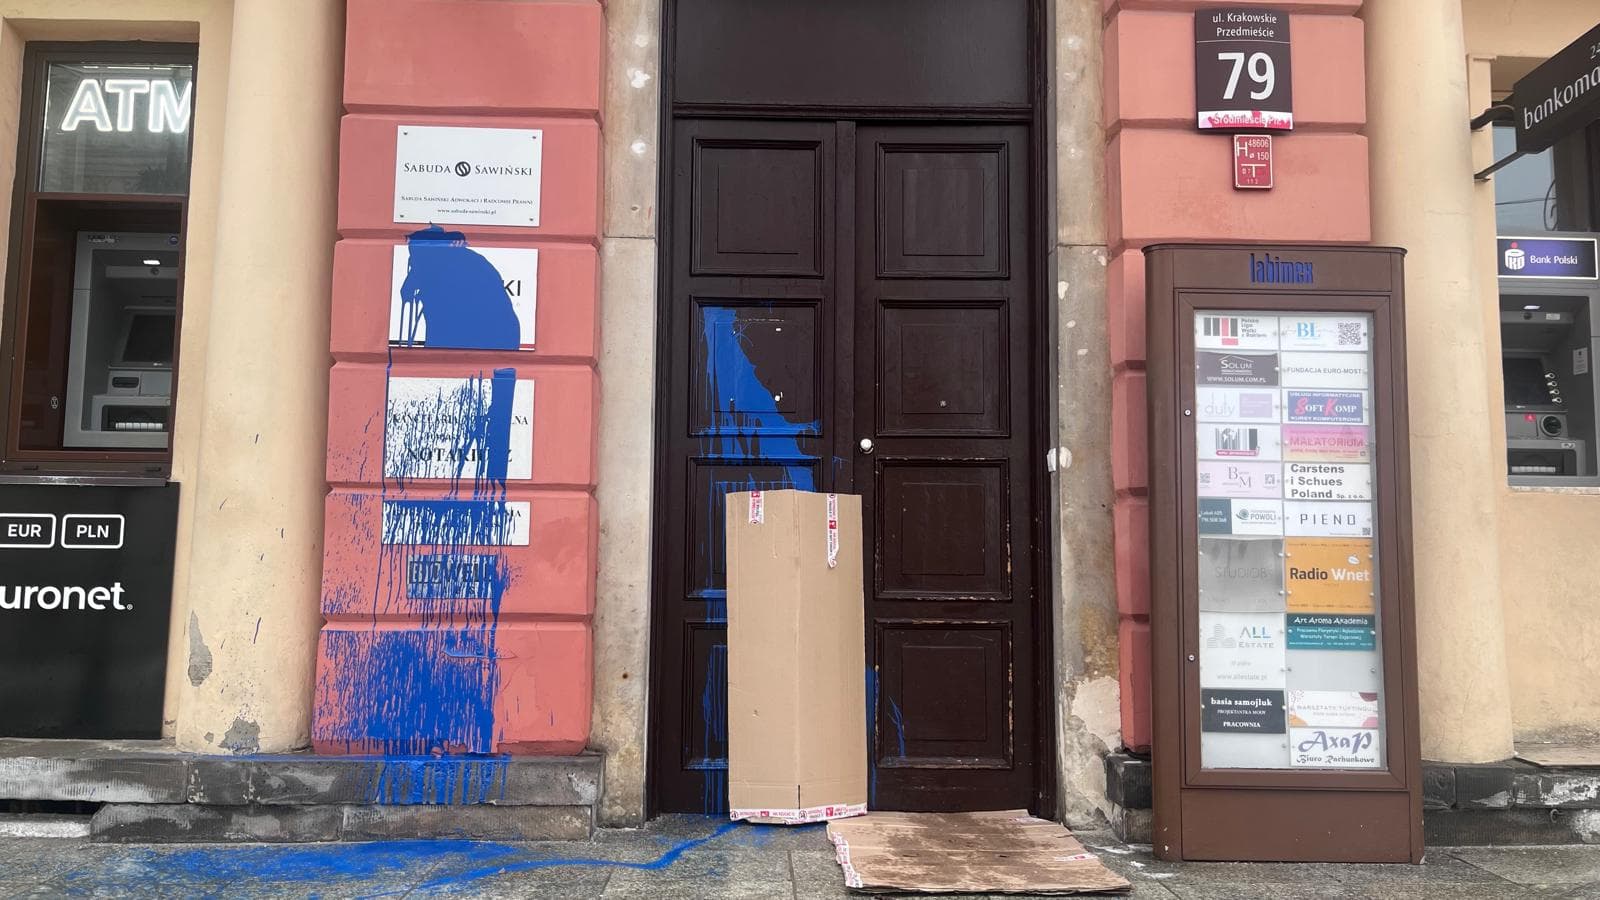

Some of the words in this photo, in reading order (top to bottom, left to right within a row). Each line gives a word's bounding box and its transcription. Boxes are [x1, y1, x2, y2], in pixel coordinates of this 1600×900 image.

[1212, 13, 1224, 23] ul.
[1227, 13, 1277, 24] Krakowskie
[1216, 27, 1275, 38] Przedmieście
[1218, 52, 1276, 101] 79
[61, 78, 193, 133] ATM
[1257, 151, 1270, 160] 150
[403, 162, 452, 174] SABUDA
[474, 164, 533, 176] SAWIŃSKI
[1530, 255, 1552, 264] Bank
[1554, 255, 1578, 265] Polski
[1250, 253, 1314, 284] labimex
[1290, 463, 1345, 473] Carstens
[1298, 476, 1343, 486] Schues
[1291, 489, 1333, 498] Poland
[7, 524, 42, 538] EUR
[76, 525, 109, 538] PLN
[1290, 567, 1328, 580] Radio
[1331, 568, 1370, 581] Wnet
[1240, 626, 1272, 639] ALL
[1210, 697, 1233, 705] basia
